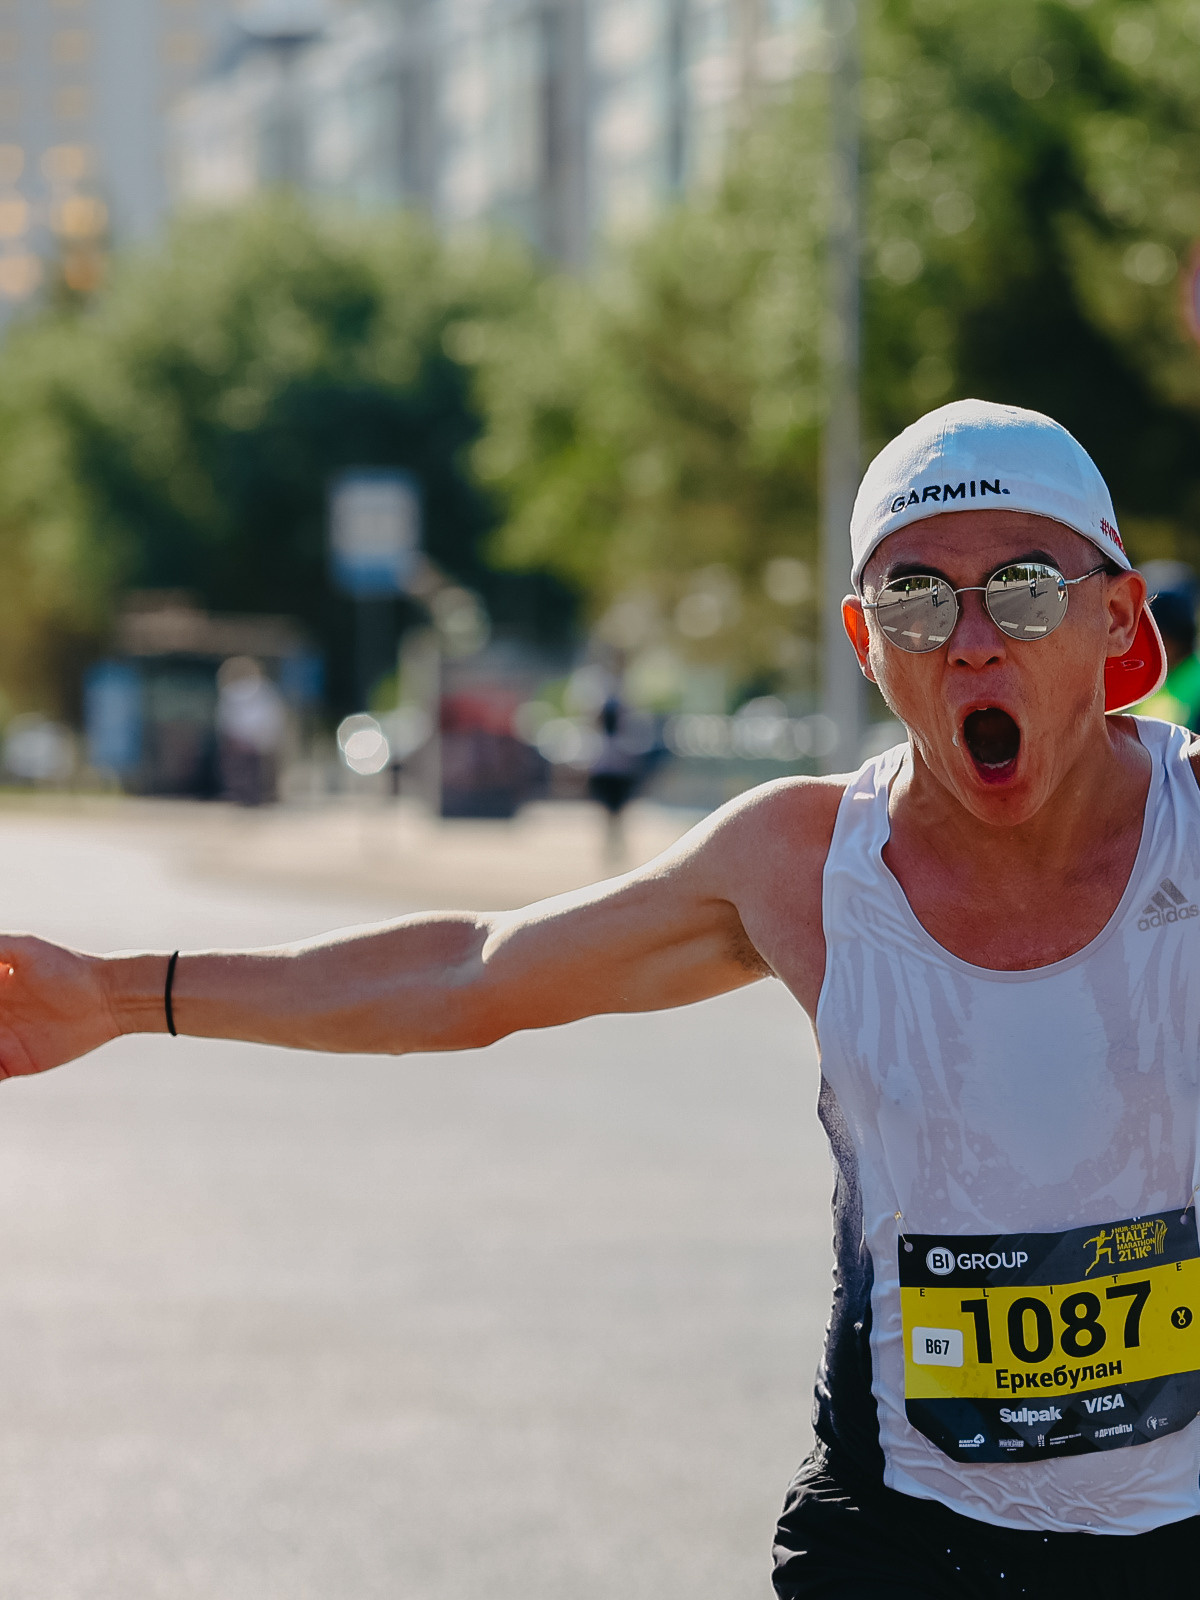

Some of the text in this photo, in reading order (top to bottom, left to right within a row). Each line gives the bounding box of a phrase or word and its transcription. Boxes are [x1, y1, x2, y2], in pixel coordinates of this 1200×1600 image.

[1137, 904, 1199, 931] adidas
[1114, 1221, 1154, 1234] NUR-SULTAN
[1115, 1228, 1148, 1244] HALF
[1117, 1237, 1156, 1251] MARATHON
[957, 1251, 1028, 1270] GROUP
[961, 1280, 1151, 1364] 1087
[925, 1338, 950, 1355] B67
[996, 1360, 1123, 1393] Еркебулан
[1081, 1393, 1125, 1414] VISA
[1000, 1406, 1063, 1426] Sulpak
